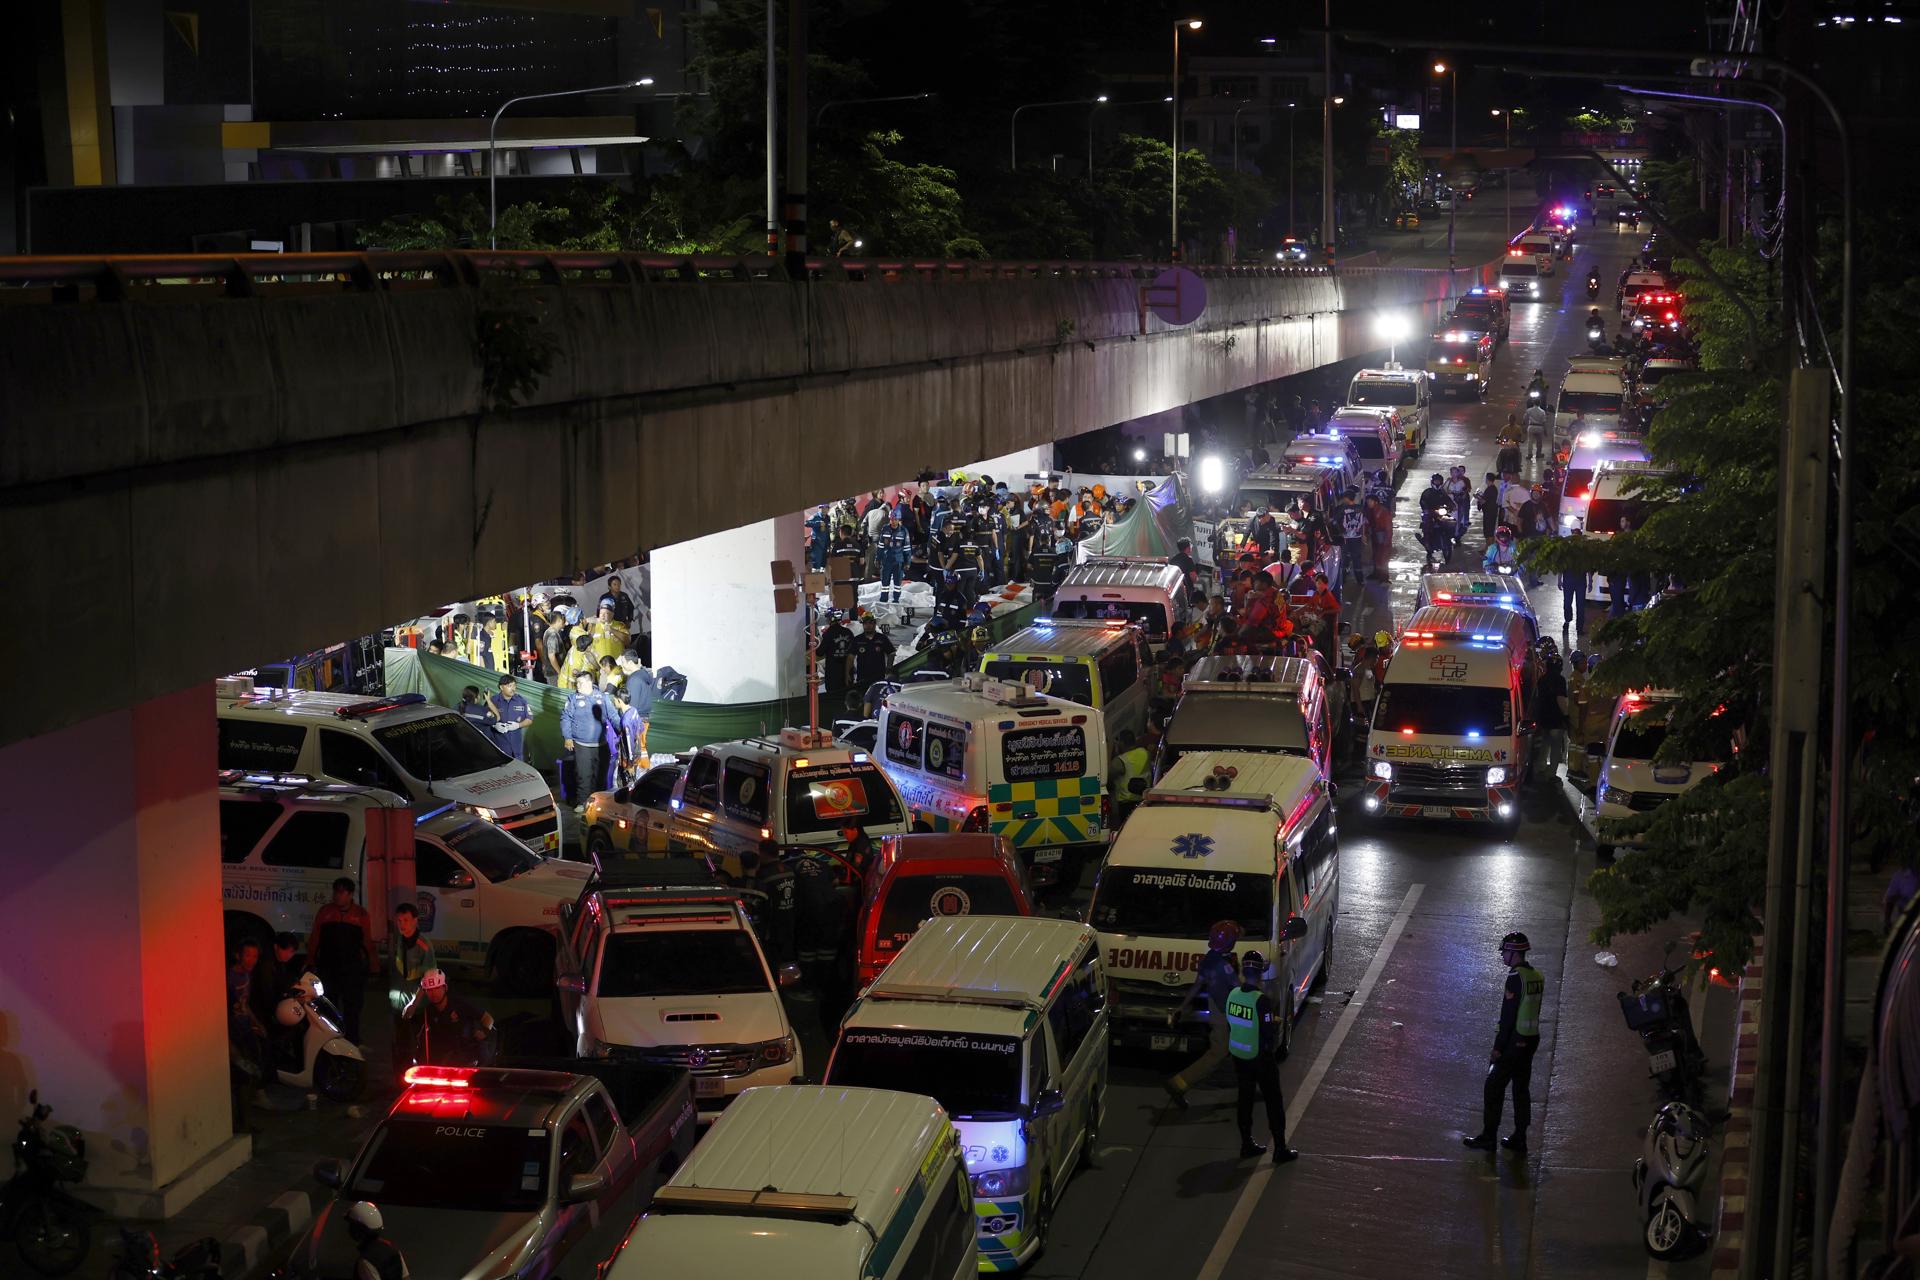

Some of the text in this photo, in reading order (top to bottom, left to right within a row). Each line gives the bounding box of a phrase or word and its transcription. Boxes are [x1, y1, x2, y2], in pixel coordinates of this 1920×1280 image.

[1054, 760, 1080, 773] 1418
[1087, 826, 1097, 834] 76
[1132, 873, 1236, 892] อาสามูลนิธิ ป่อเต็กตึ๊ง
[970, 1041, 1017, 1055] จ.นนทบุรี
[435, 1126, 487, 1138] POLICE
